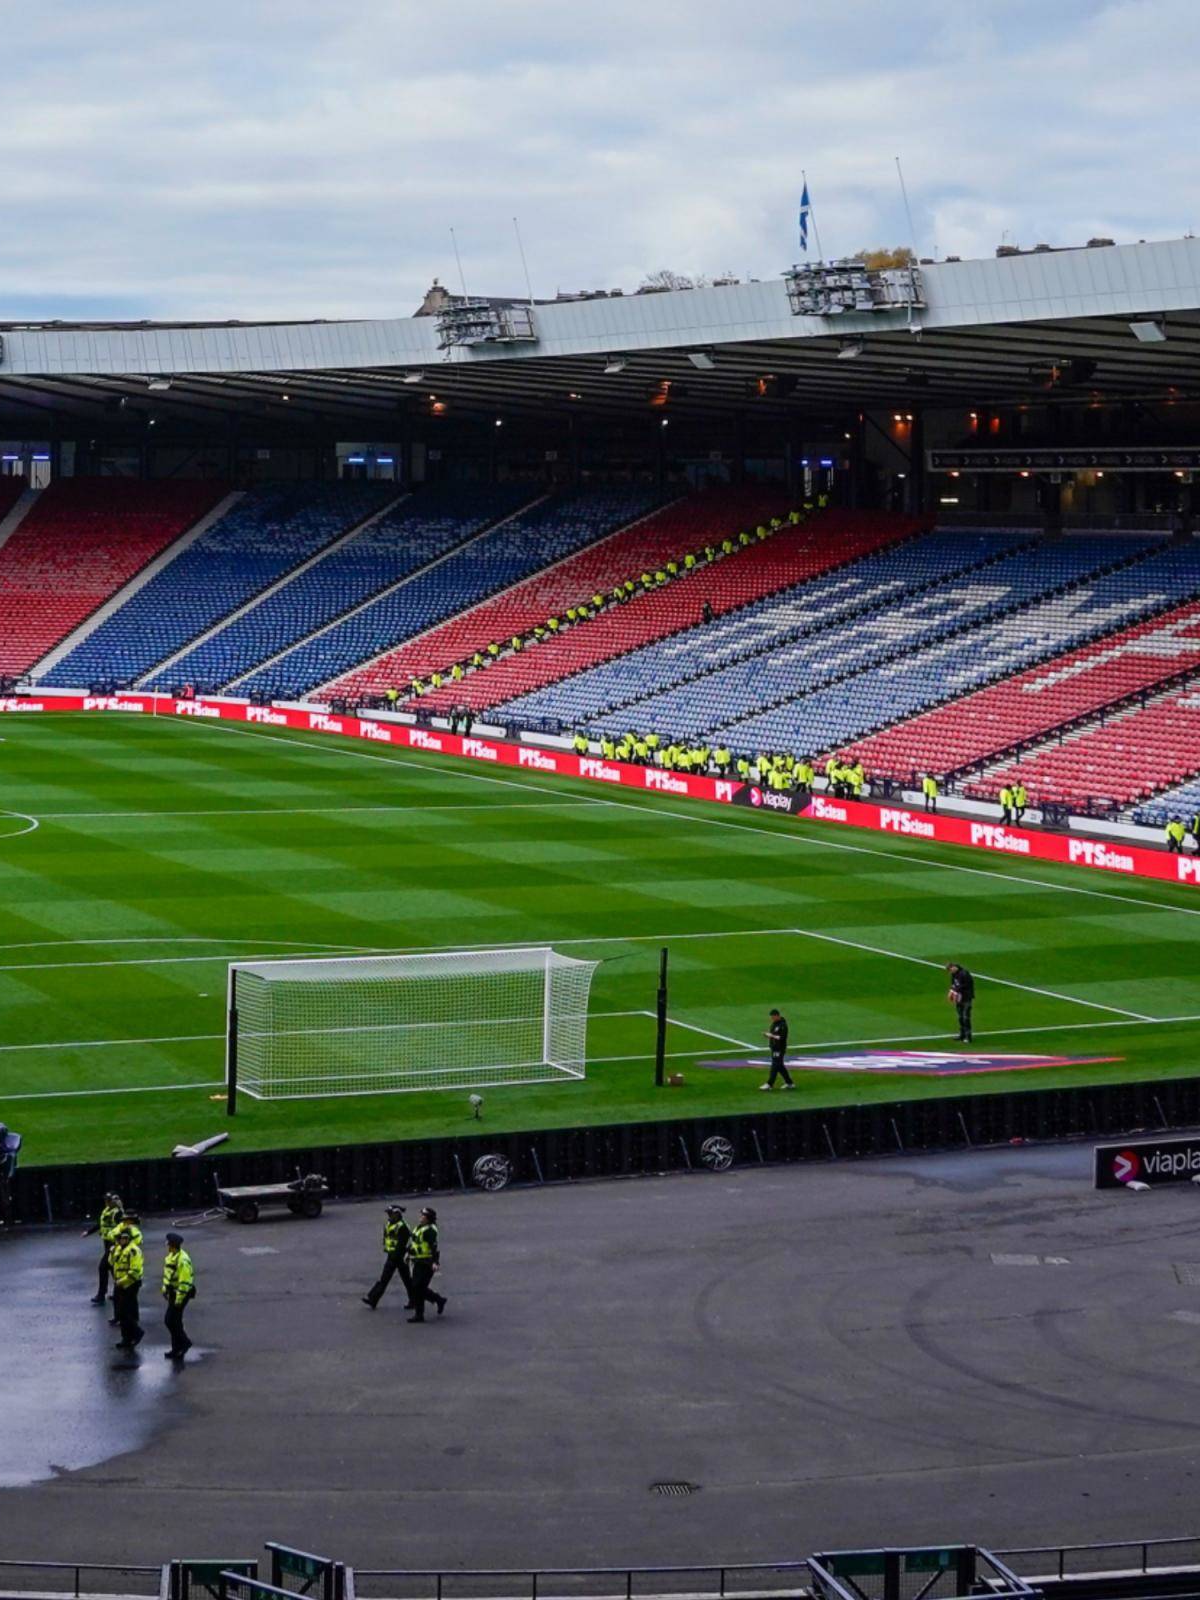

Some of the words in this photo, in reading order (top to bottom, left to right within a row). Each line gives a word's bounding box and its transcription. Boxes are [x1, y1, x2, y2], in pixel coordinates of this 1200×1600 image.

[762, 790, 792, 811] viaplay
[880, 808, 934, 836] PTSclean
[971, 823, 1029, 853] PTSclean
[1069, 839, 1134, 872] PTSclean
